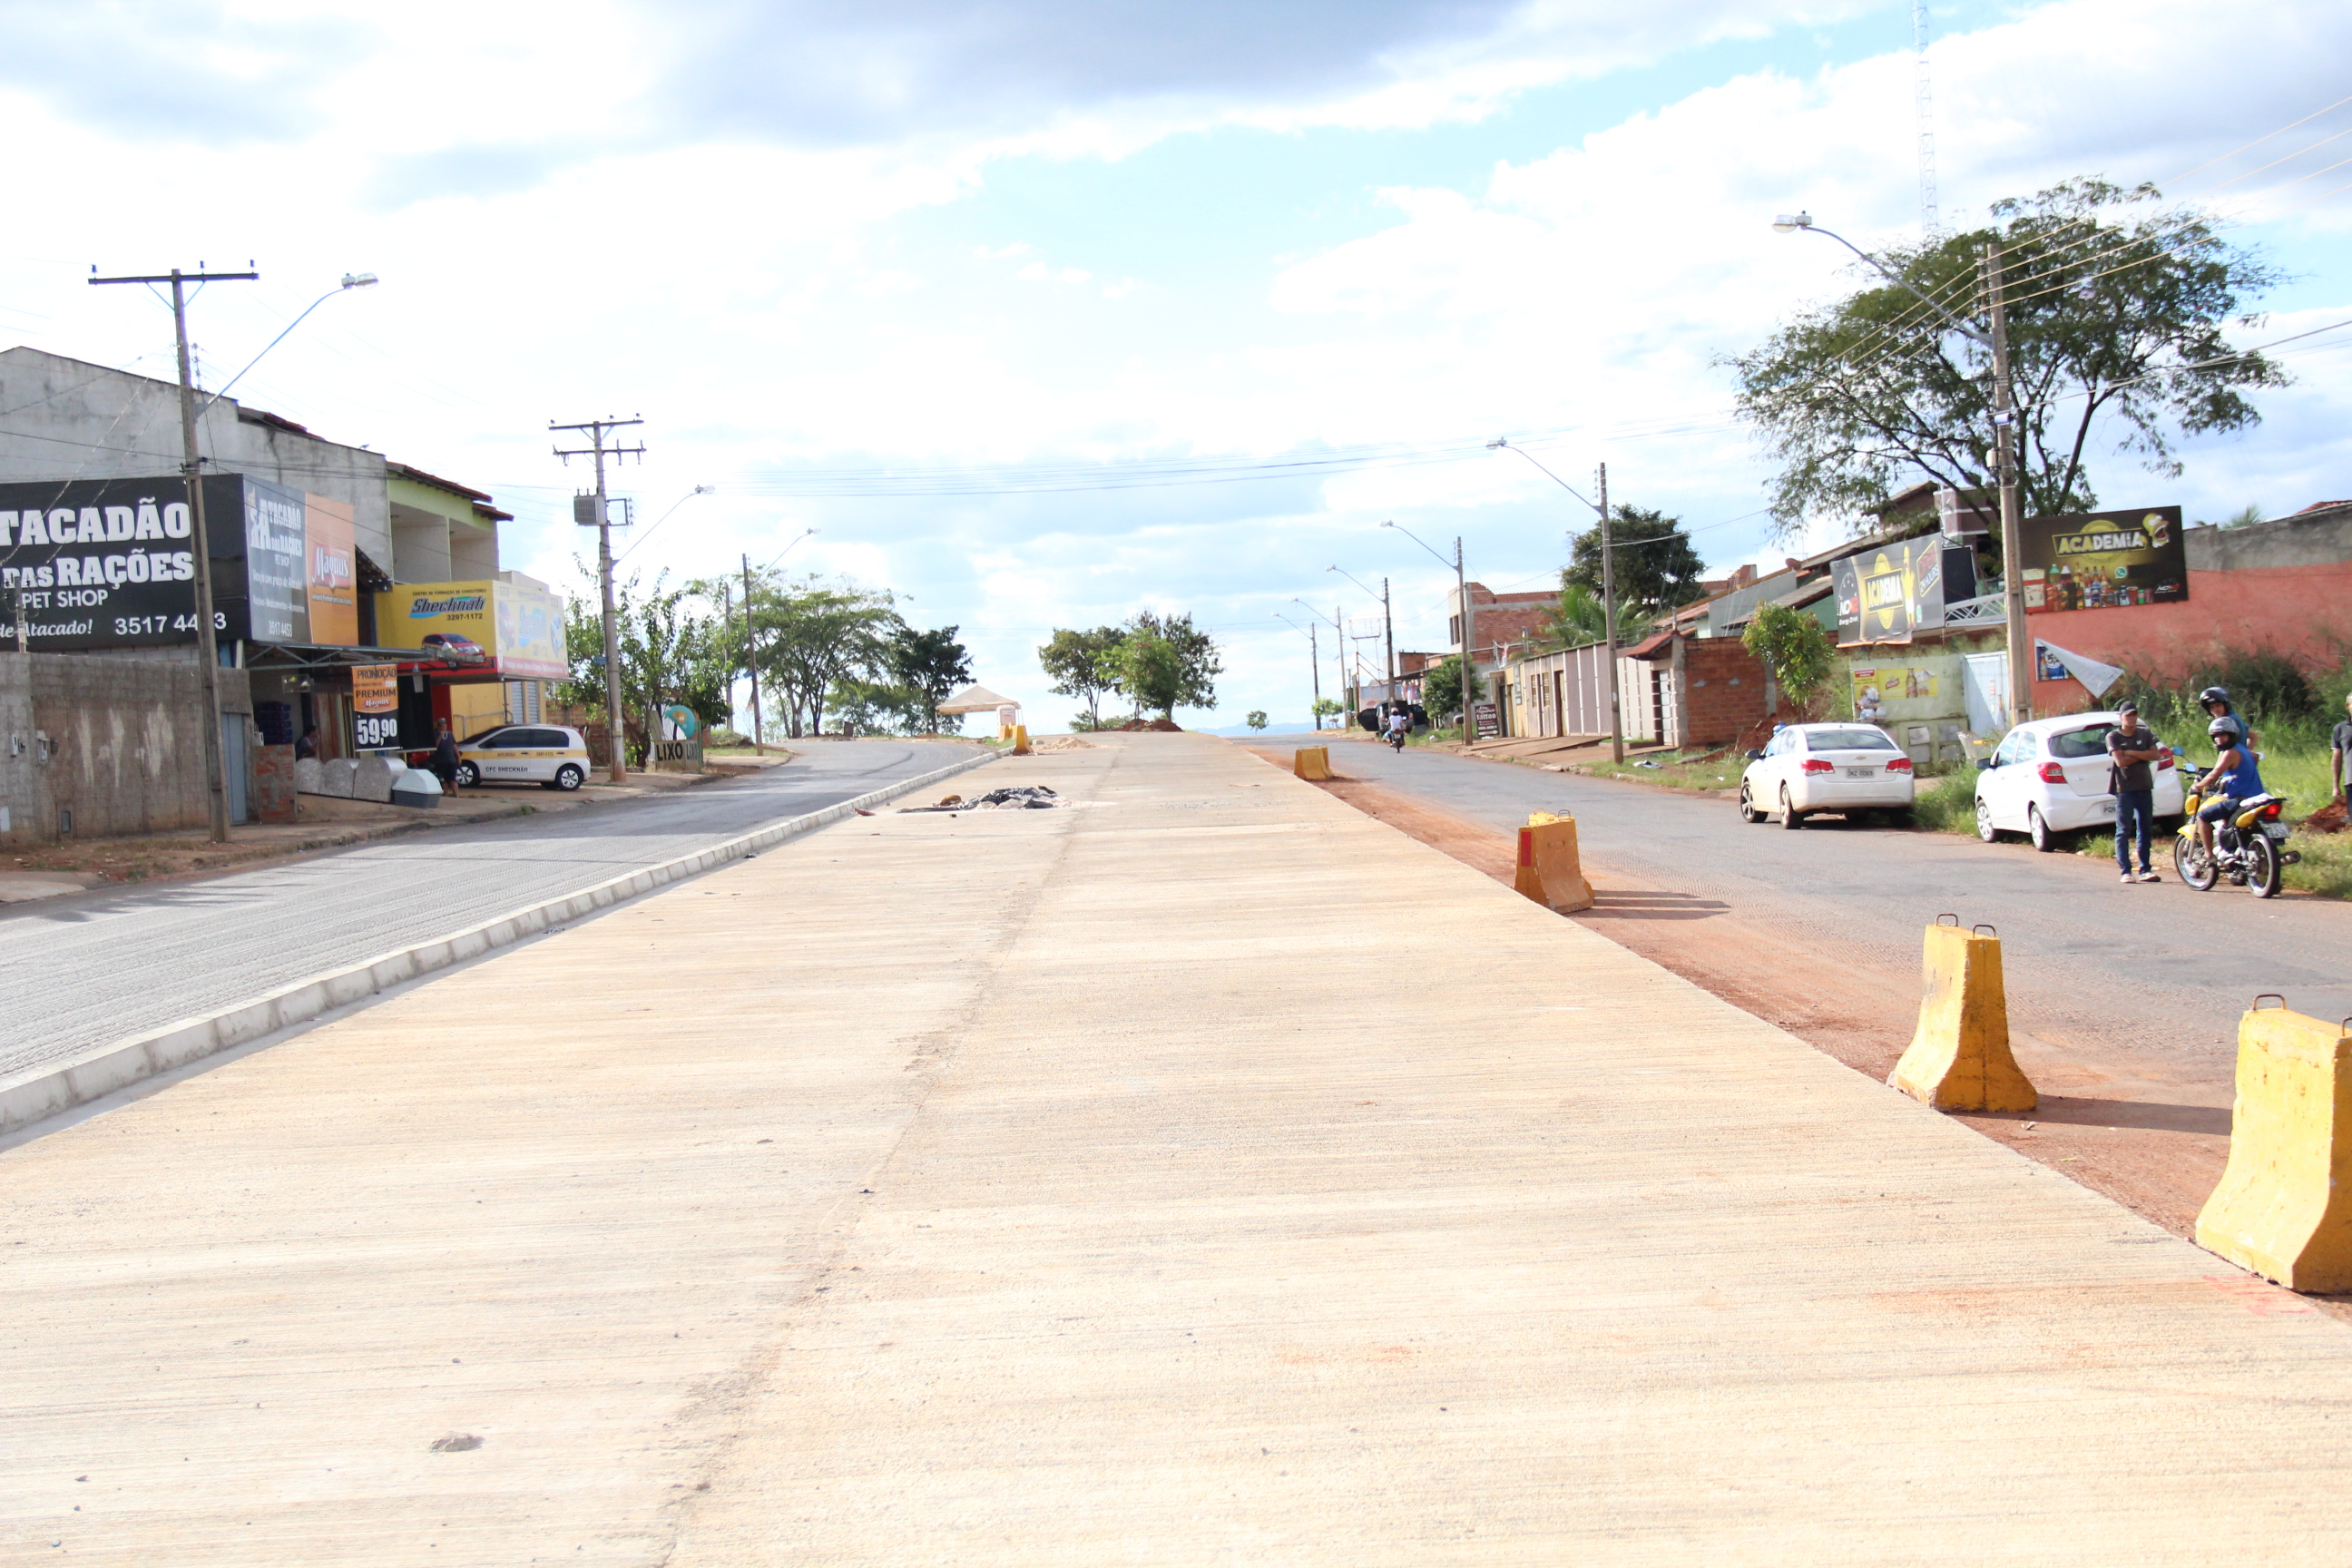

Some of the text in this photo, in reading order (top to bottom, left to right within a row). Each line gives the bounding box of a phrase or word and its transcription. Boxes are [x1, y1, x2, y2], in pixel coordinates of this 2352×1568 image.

[2, 547, 194, 590] DAS RAÇÕES
[311, 546, 349, 589] Magnus
[22, 589, 109, 609] PET SHOP
[115, 612, 228, 635] 3517 443
[447, 612, 484, 622] 3297-1172
[269, 620, 280, 635] 3517
[356, 690, 397, 698] PREMIUM
[363, 699, 390, 708] Magnus
[358, 718, 397, 746] 59,90
[656, 742, 683, 761] LIXO
